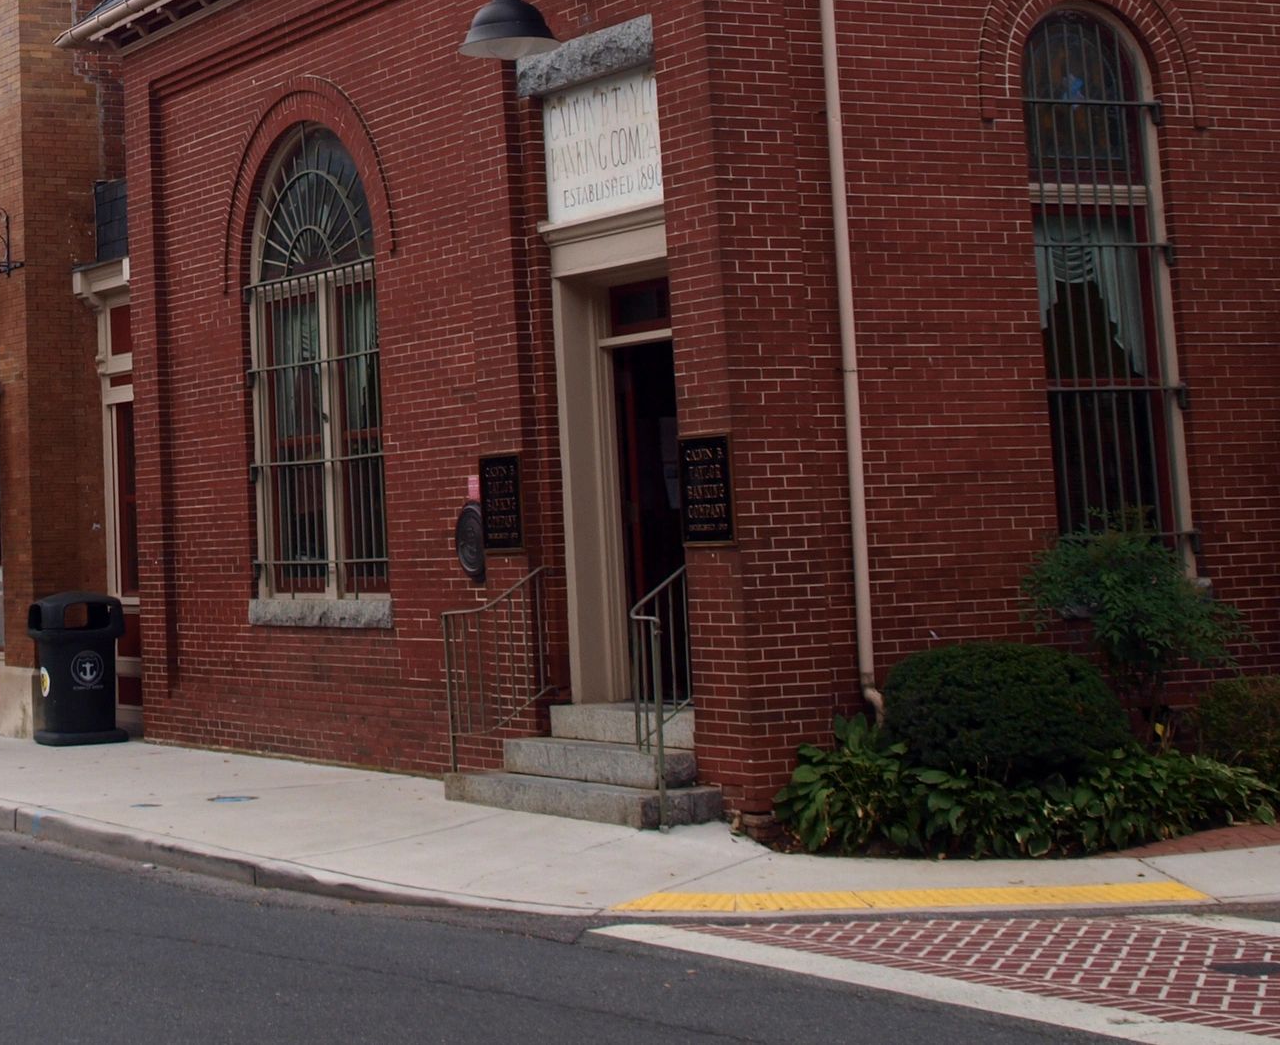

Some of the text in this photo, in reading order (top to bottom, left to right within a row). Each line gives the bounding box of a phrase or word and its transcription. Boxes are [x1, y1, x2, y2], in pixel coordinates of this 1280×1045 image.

[549, 91, 597, 141] CALVIN
[550, 132, 608, 182] BANKING
[563, 175, 634, 209] ESTABLISHED
[688, 503, 727, 519] COMPANY
